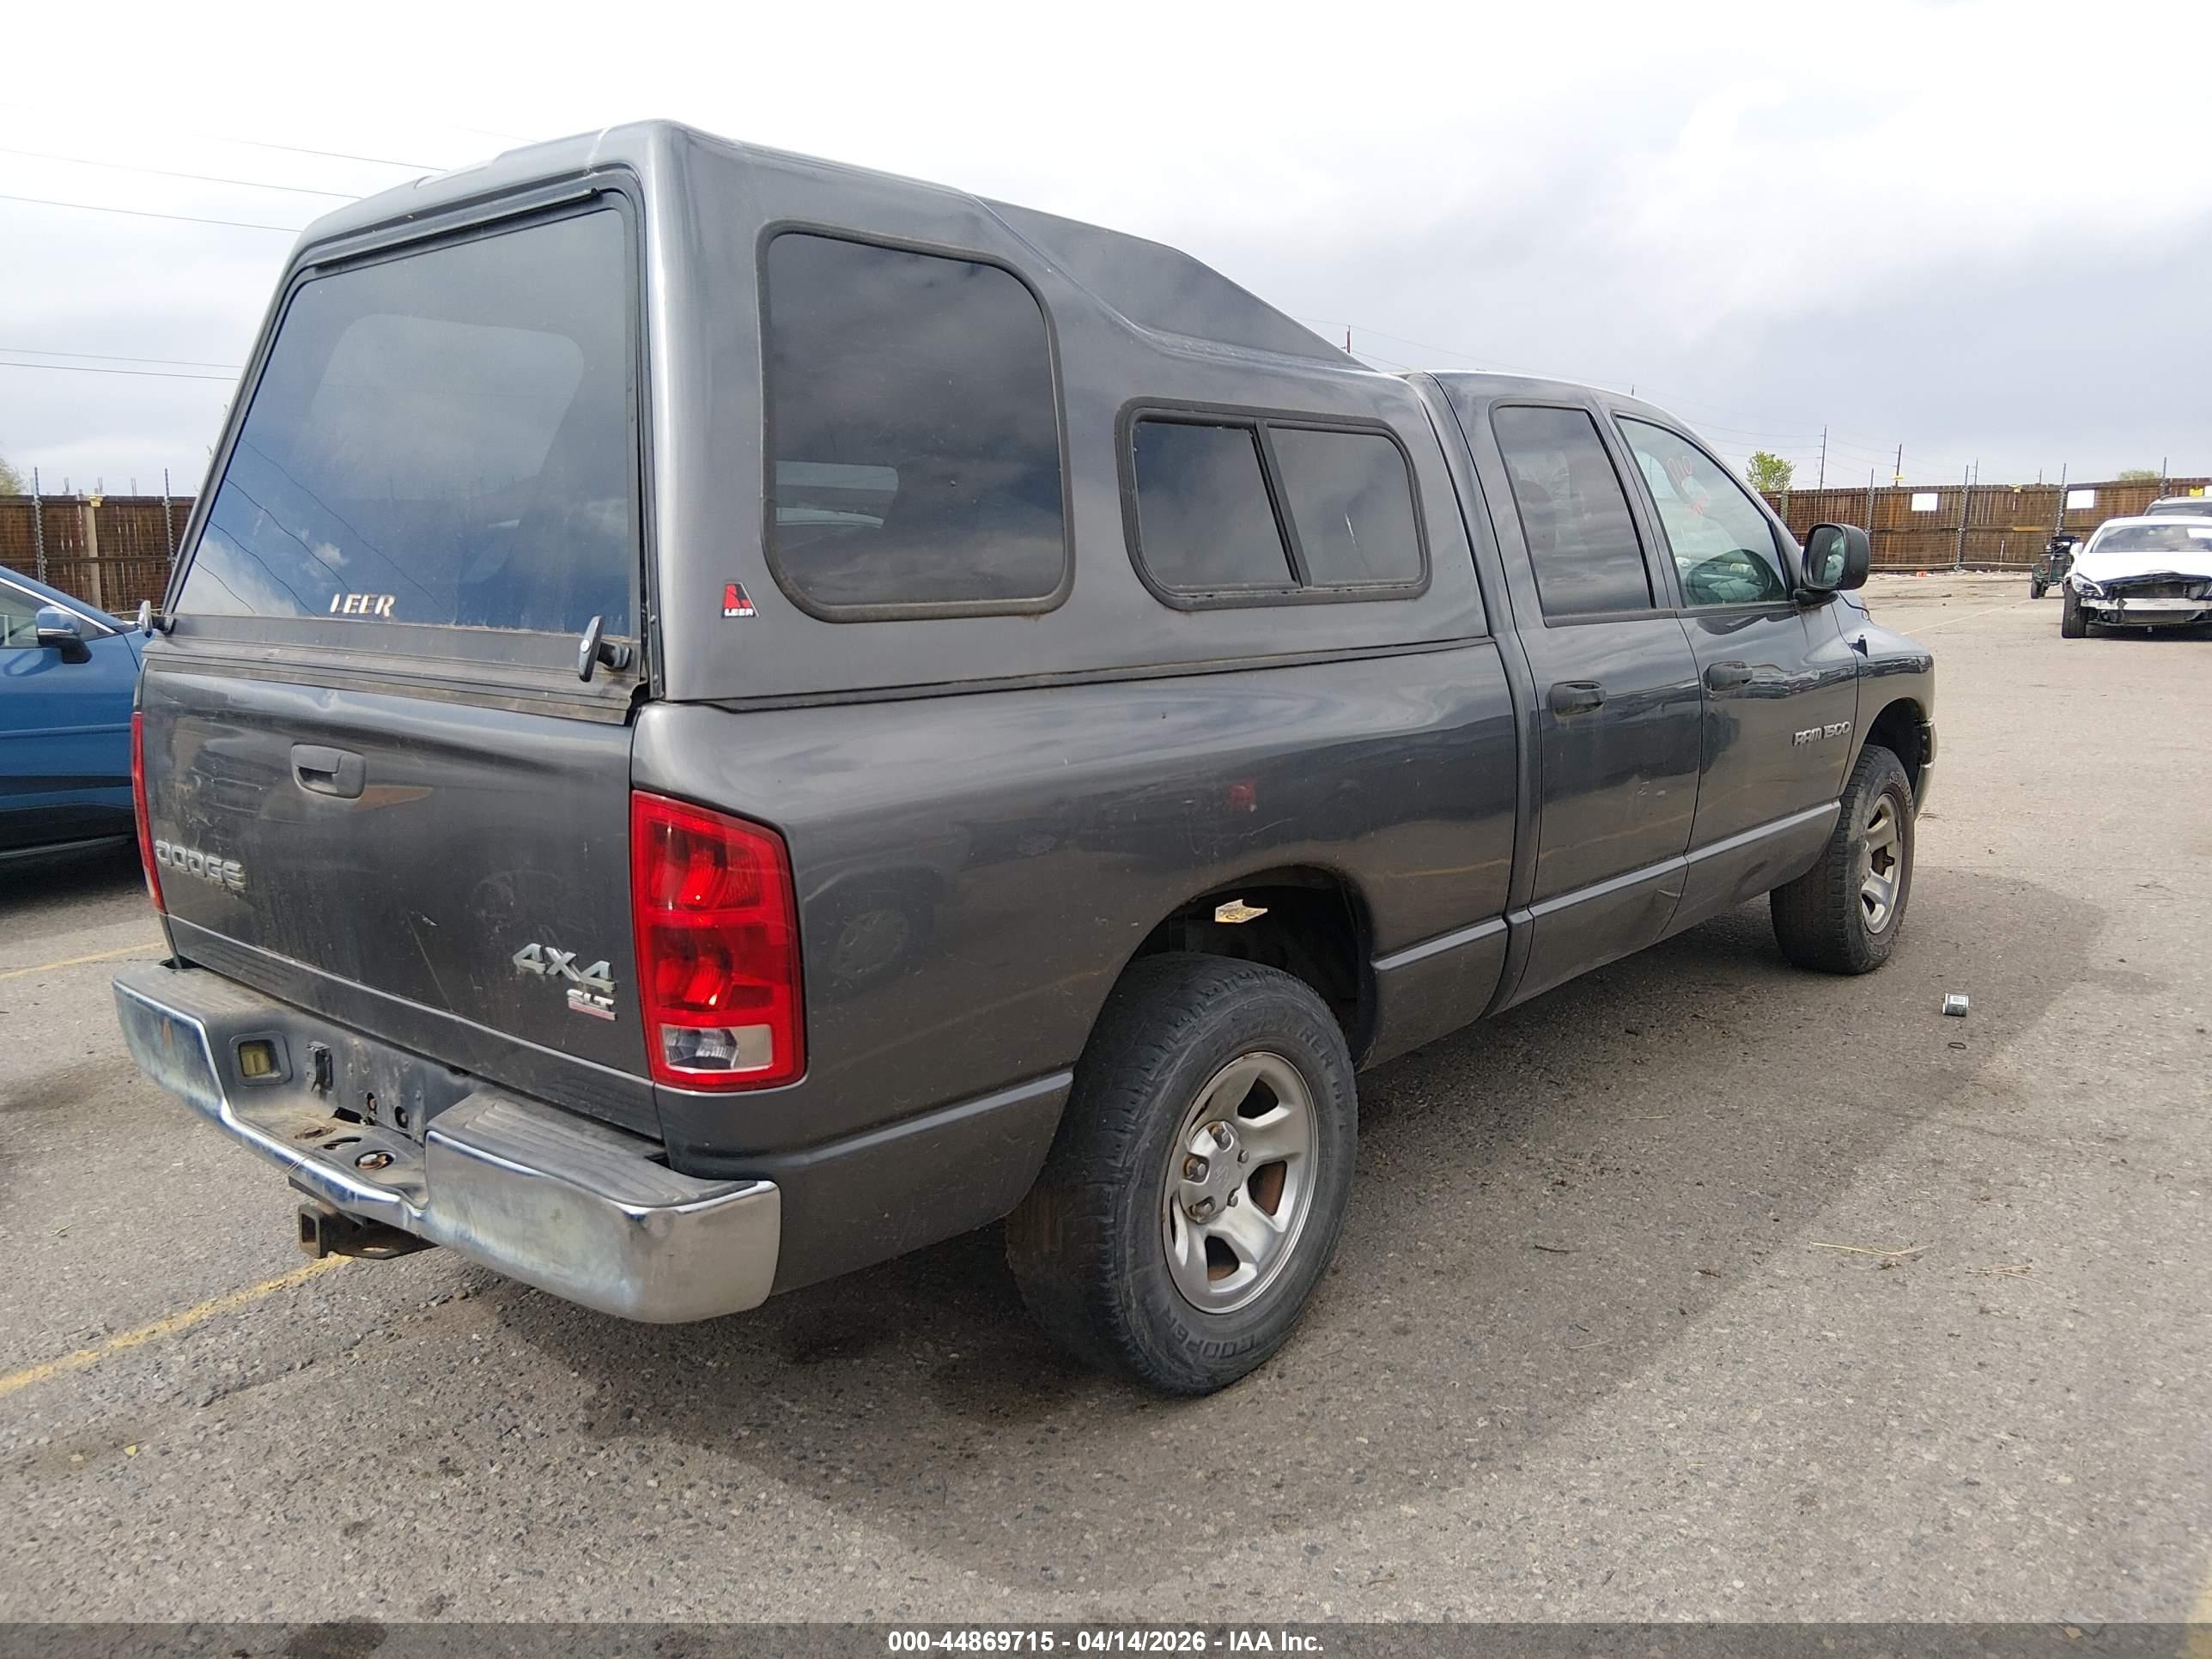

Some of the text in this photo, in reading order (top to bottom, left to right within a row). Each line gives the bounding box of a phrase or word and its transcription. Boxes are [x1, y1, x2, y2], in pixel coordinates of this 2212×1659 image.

[330, 592, 396, 617] LEER
[724, 607, 754, 617] LEER
[1792, 720, 1850, 747] RAM 1500
[155, 839, 247, 893] DODGE
[566, 988, 615, 1012] SLT
